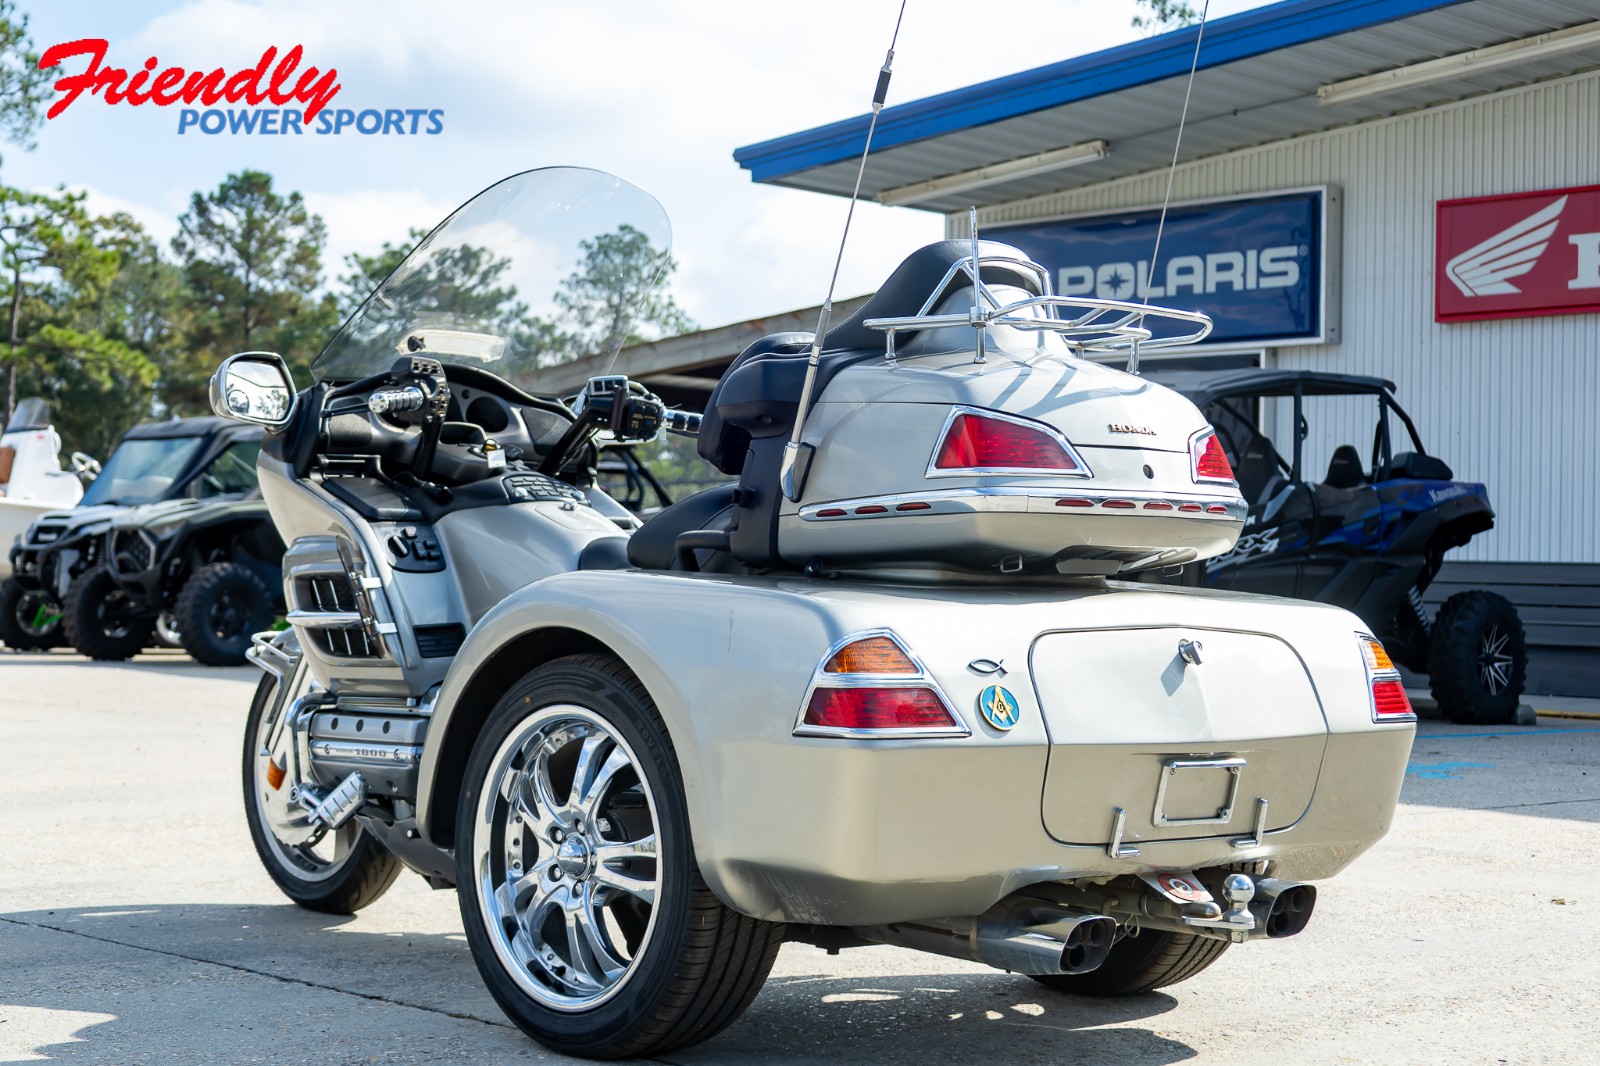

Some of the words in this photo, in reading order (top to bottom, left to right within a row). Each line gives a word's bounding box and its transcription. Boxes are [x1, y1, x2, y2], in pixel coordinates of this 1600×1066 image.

[1058, 246, 1300, 301] POLARIS
[1107, 423, 1157, 436] HONDA
[354, 748, 387, 757] 1800
